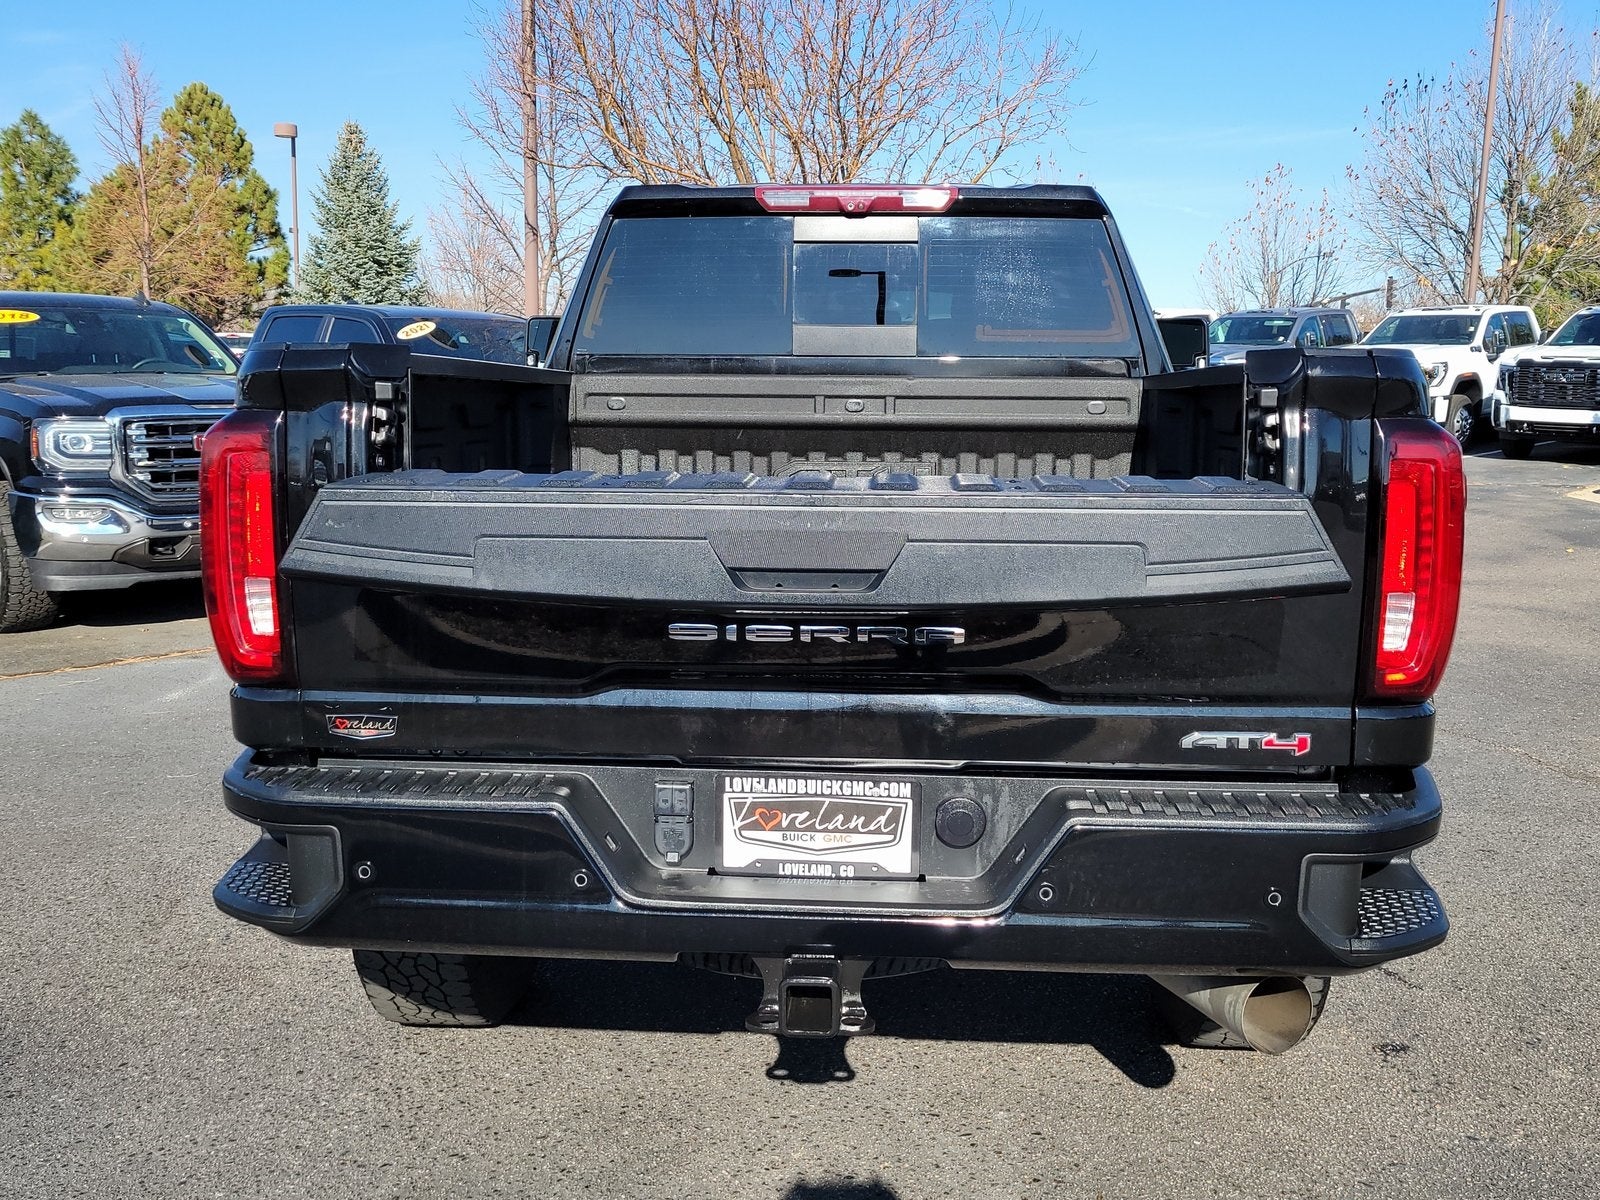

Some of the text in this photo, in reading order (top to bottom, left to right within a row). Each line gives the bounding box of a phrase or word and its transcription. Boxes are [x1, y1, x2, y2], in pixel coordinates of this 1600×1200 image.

[402, 323, 430, 337] 2021
[668, 623, 965, 645] SIERRA
[1179, 731, 1312, 757] AT4
[724, 776, 912, 798] LOVELANDBUICKGMCCOM
[781, 832, 853, 843] BUICK GMC
[778, 862, 855, 878] LOVELAND, CO
